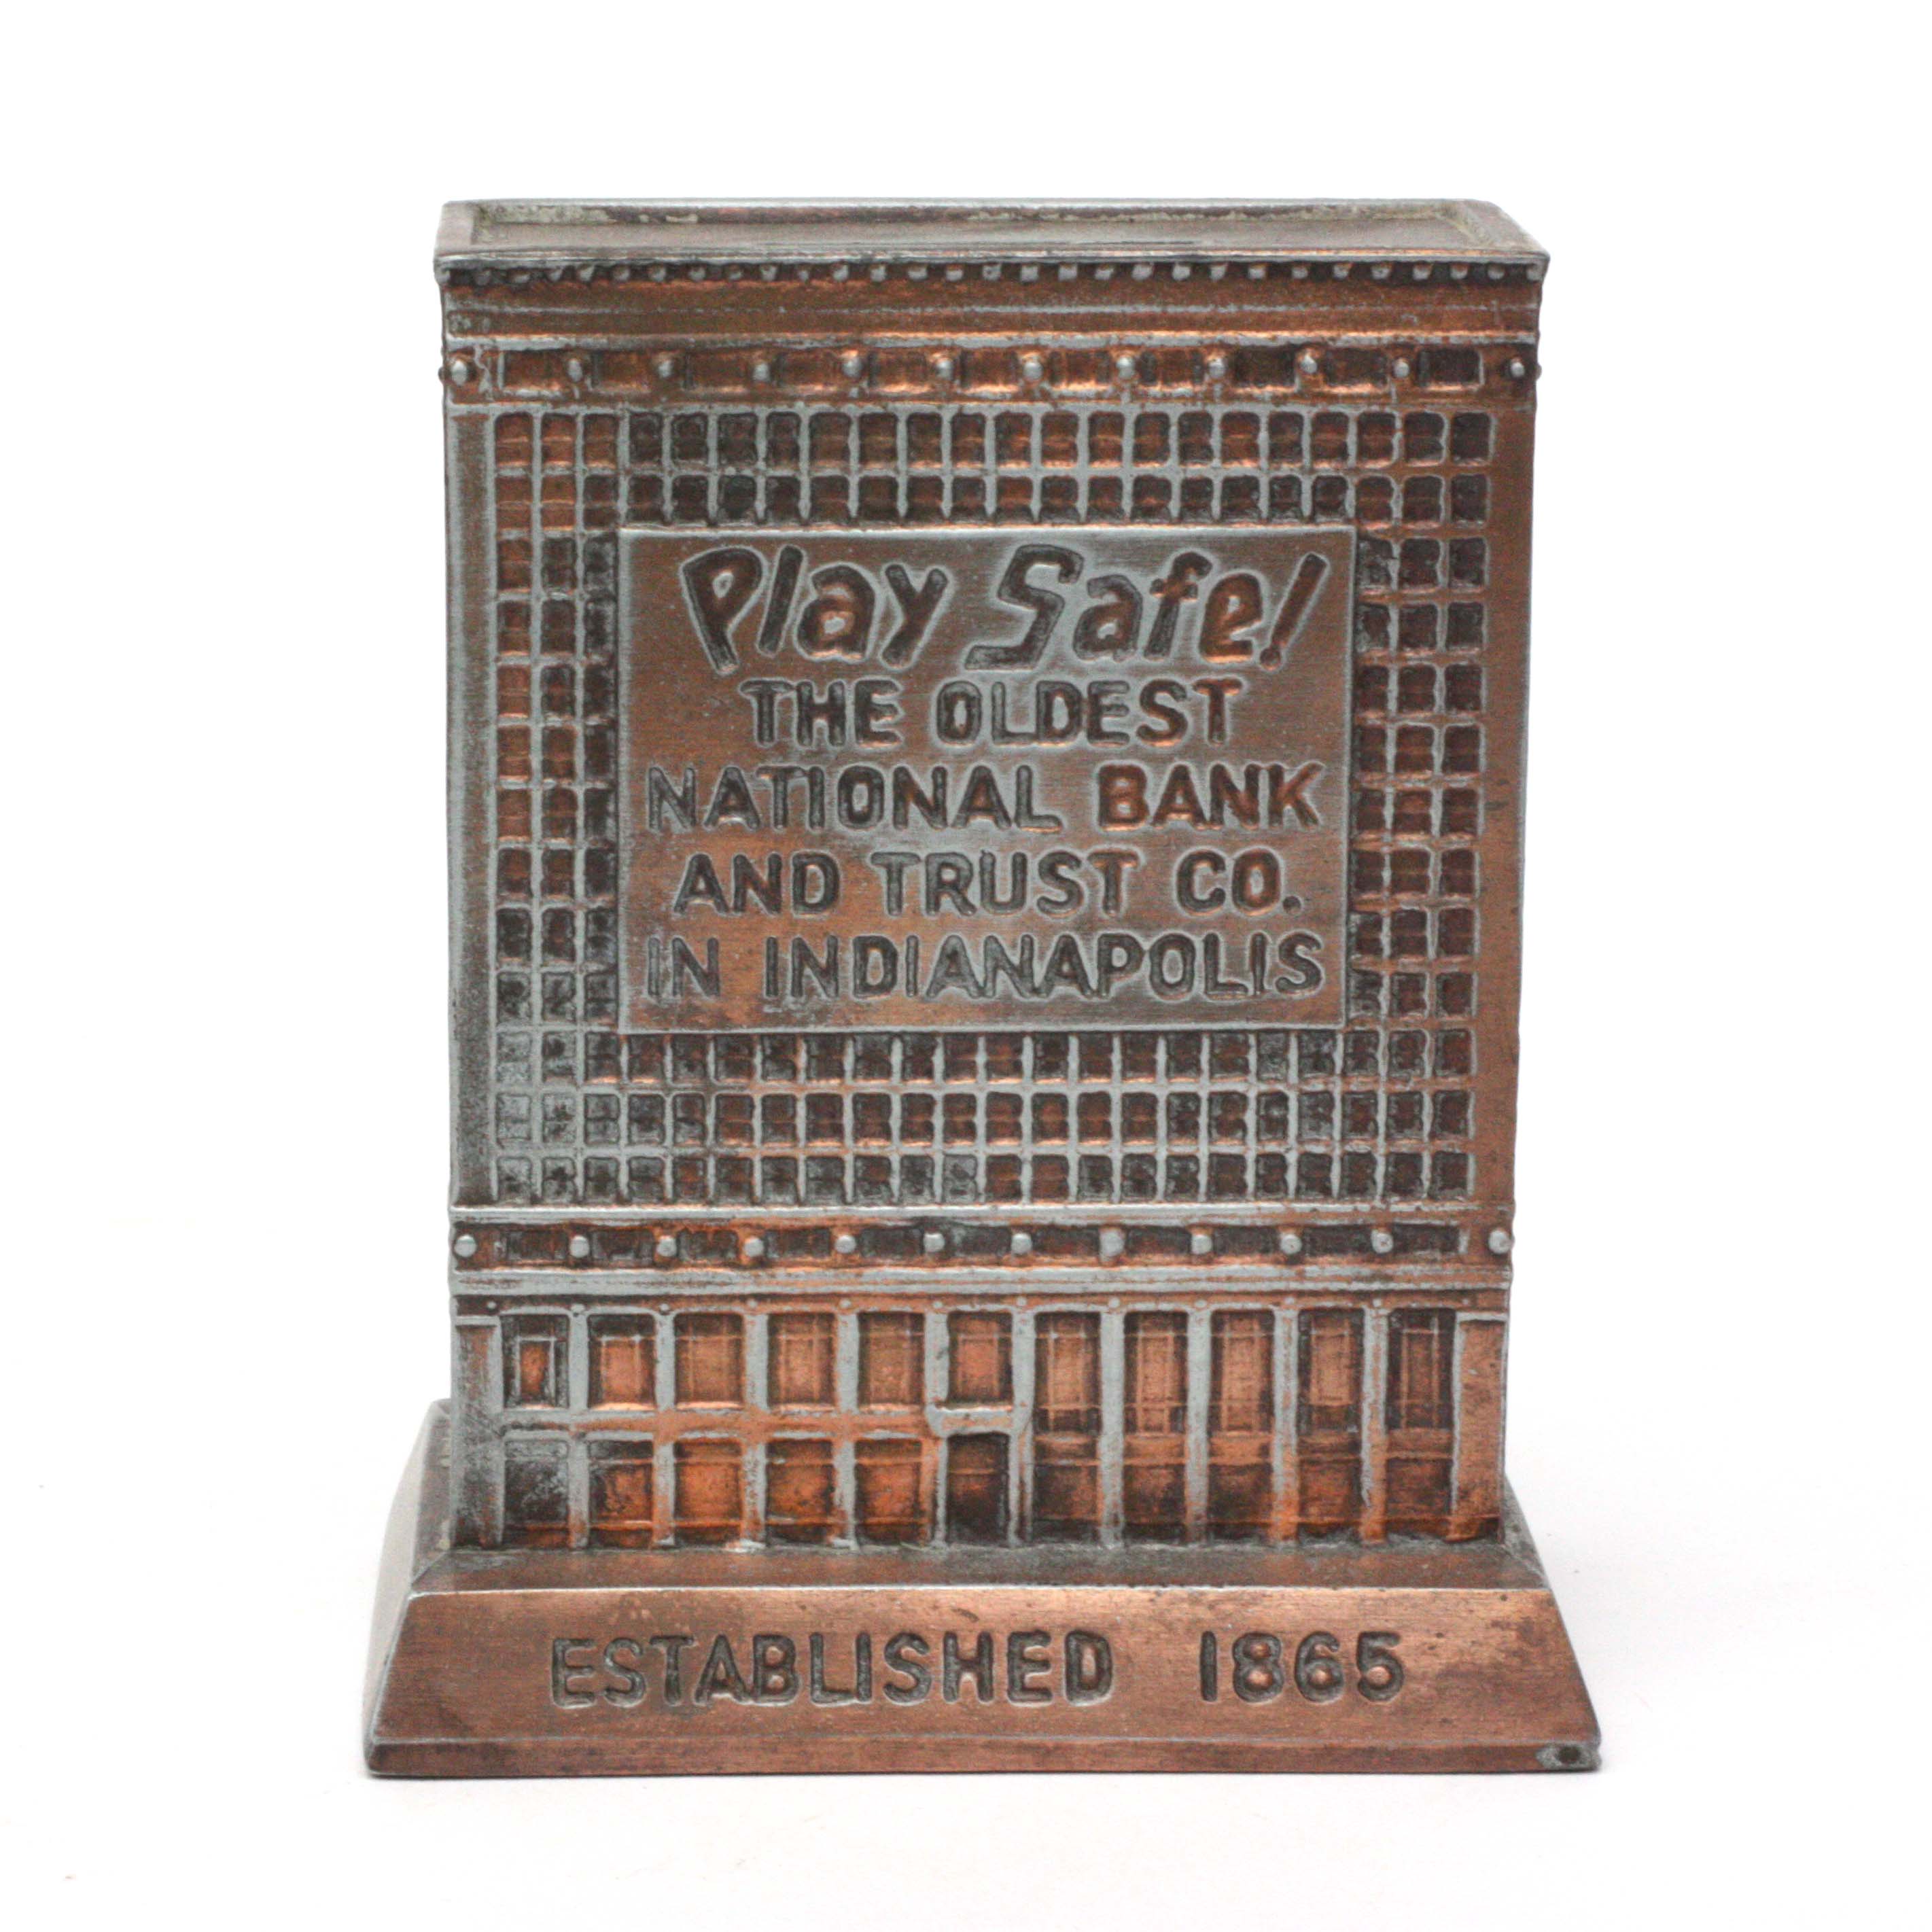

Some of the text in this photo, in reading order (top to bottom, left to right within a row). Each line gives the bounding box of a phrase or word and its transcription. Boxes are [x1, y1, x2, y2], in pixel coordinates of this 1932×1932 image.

[682, 543, 1330, 672] Play Safe!
[741, 678, 1242, 745] THE OLDEST
[648, 762, 1324, 830] NATIONAL BANK
[673, 849, 1301, 916] AND TRUST CO.
[648, 933, 1323, 1000] IN INDIANAPOLIS
[551, 1632, 1405, 1706] ESTABLISHED 1865
